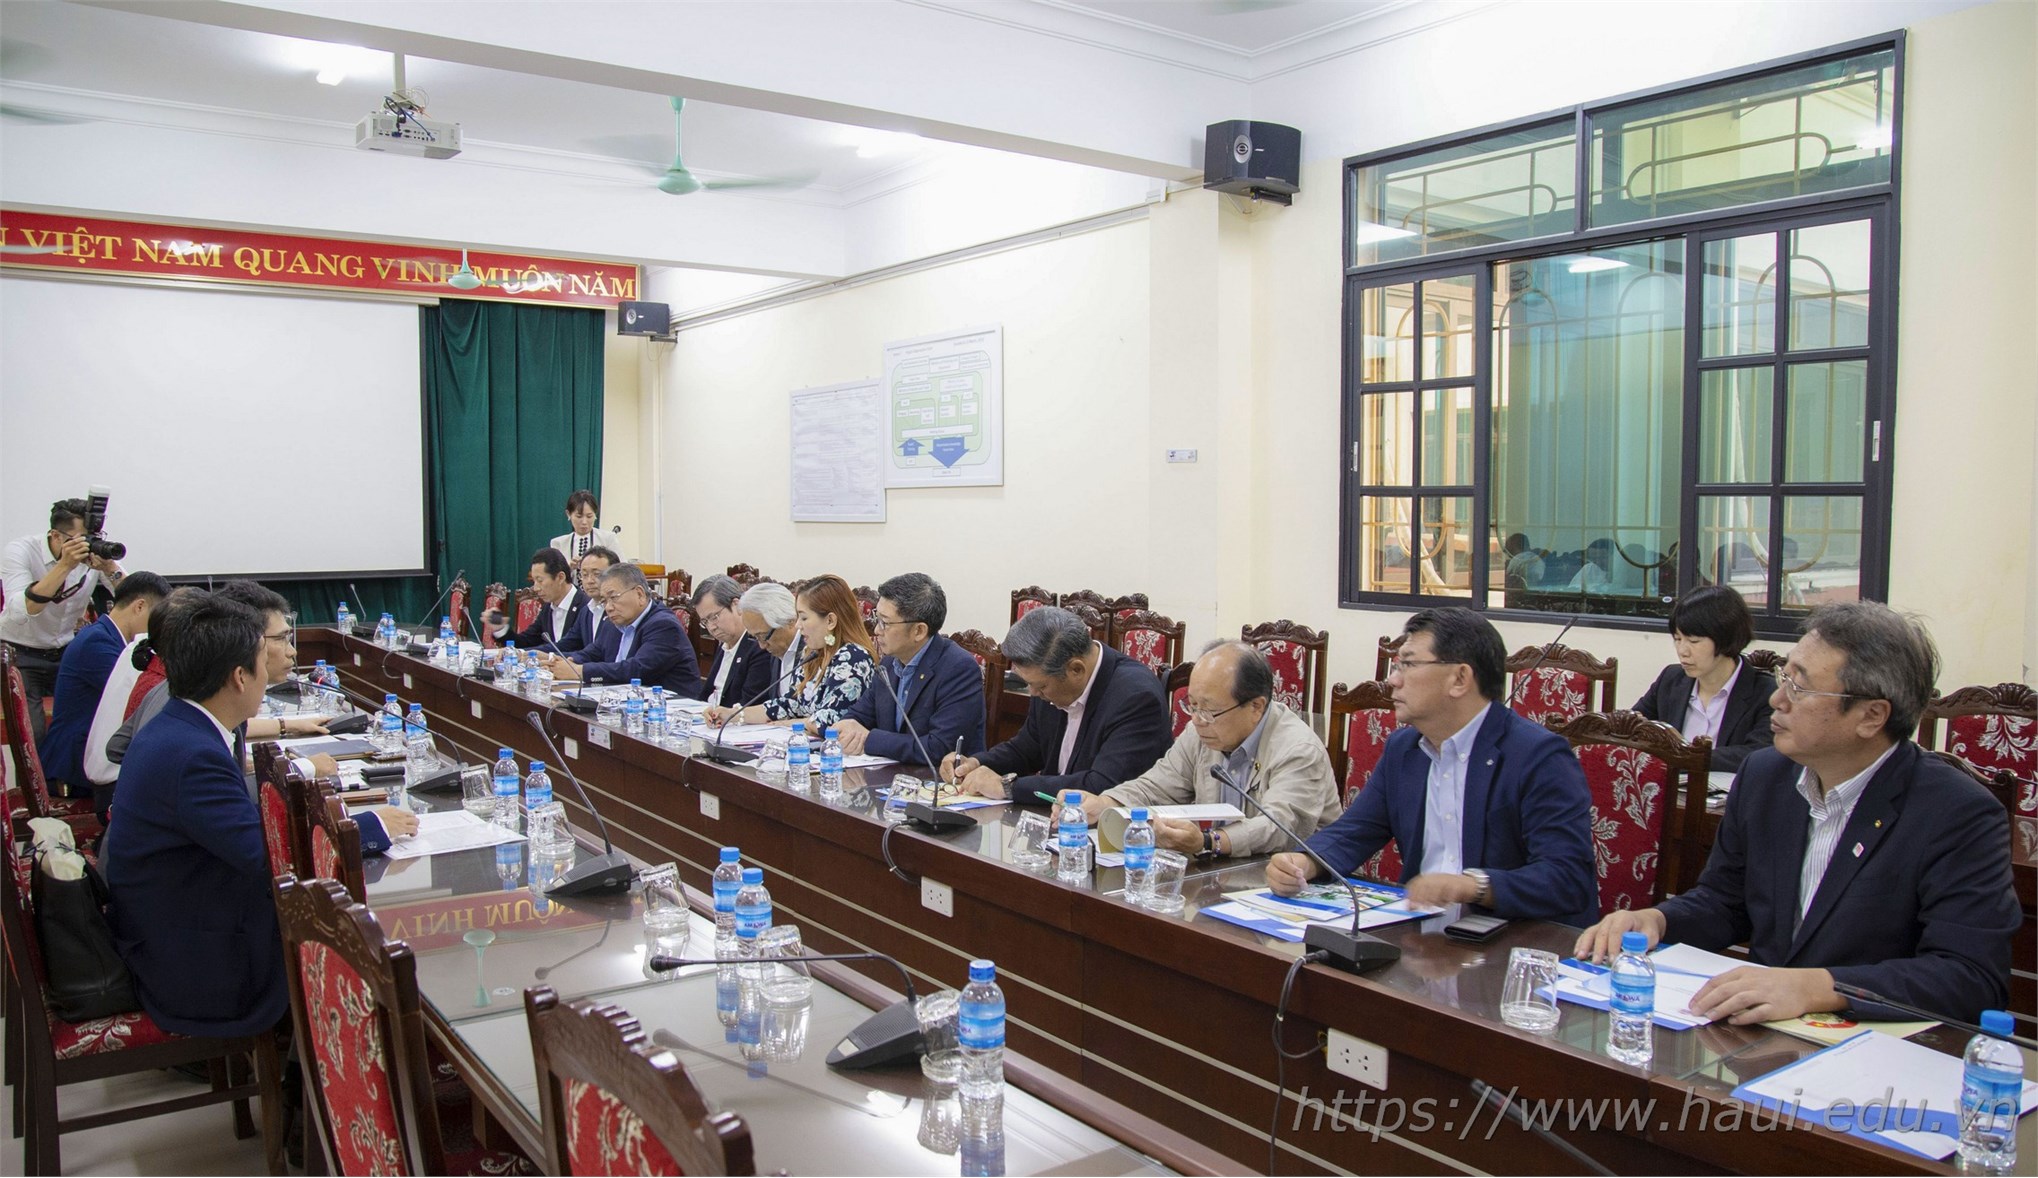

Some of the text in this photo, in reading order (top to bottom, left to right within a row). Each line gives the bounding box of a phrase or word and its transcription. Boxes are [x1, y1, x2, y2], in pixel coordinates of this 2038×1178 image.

[20, 226, 122, 264] VIỆT
[132, 238, 224, 268] NAM
[233, 246, 366, 278] QUANG
[569, 270, 636, 299] NĂM
